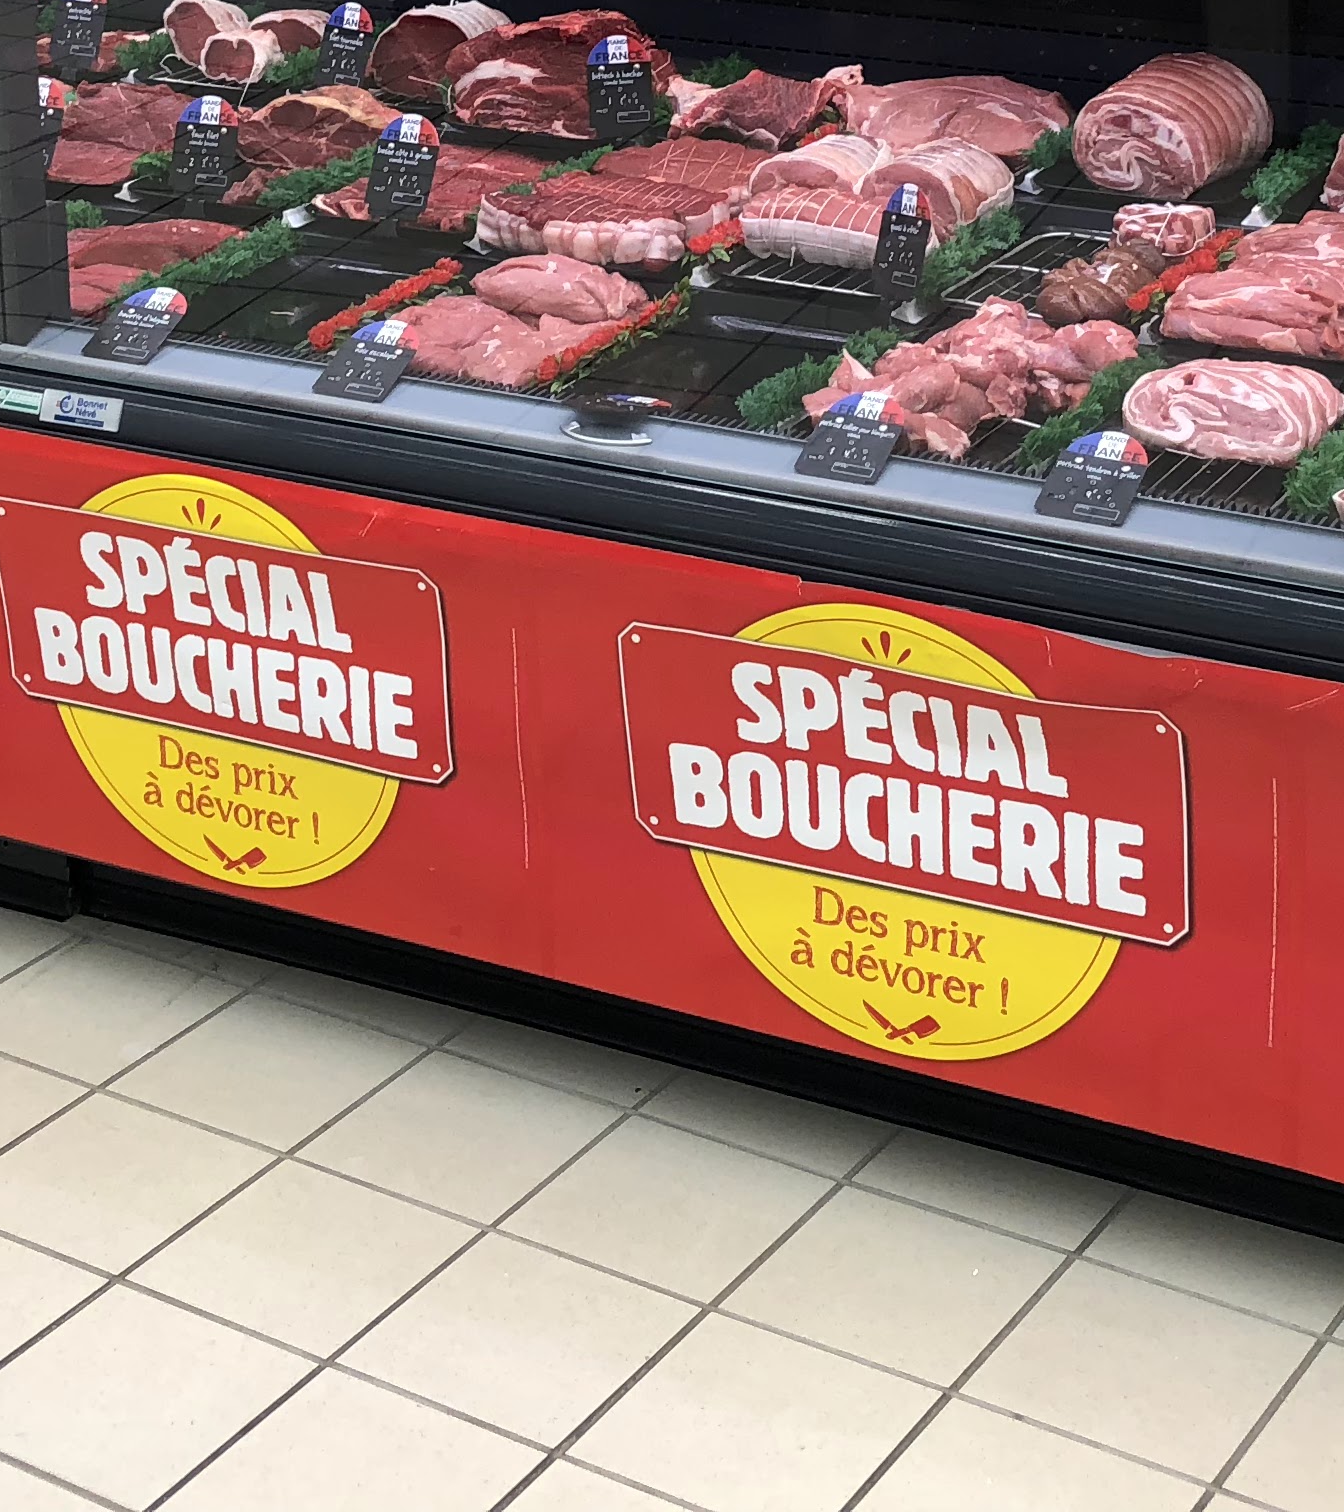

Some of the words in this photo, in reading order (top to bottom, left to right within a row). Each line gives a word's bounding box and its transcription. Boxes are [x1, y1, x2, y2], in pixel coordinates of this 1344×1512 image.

[77, 397, 108, 411] Bonnet
[1078, 443, 1144, 464] FRANCE
[79, 530, 352, 653] SPÉCIAL
[34, 606, 418, 759] BOUCHERIE
[159, 734, 219, 780] Des
[232, 759, 299, 800] prix
[730, 660, 1069, 798] SPÉCIAL
[143, 771, 163, 808] à
[176, 781, 300, 839] dévorer
[668, 742, 1147, 916] BOUCHERIE
[812, 885, 888, 939] Des
[903, 920, 986, 964] prix
[790, 928, 815, 970] à
[831, 942, 985, 1009] dévorer
